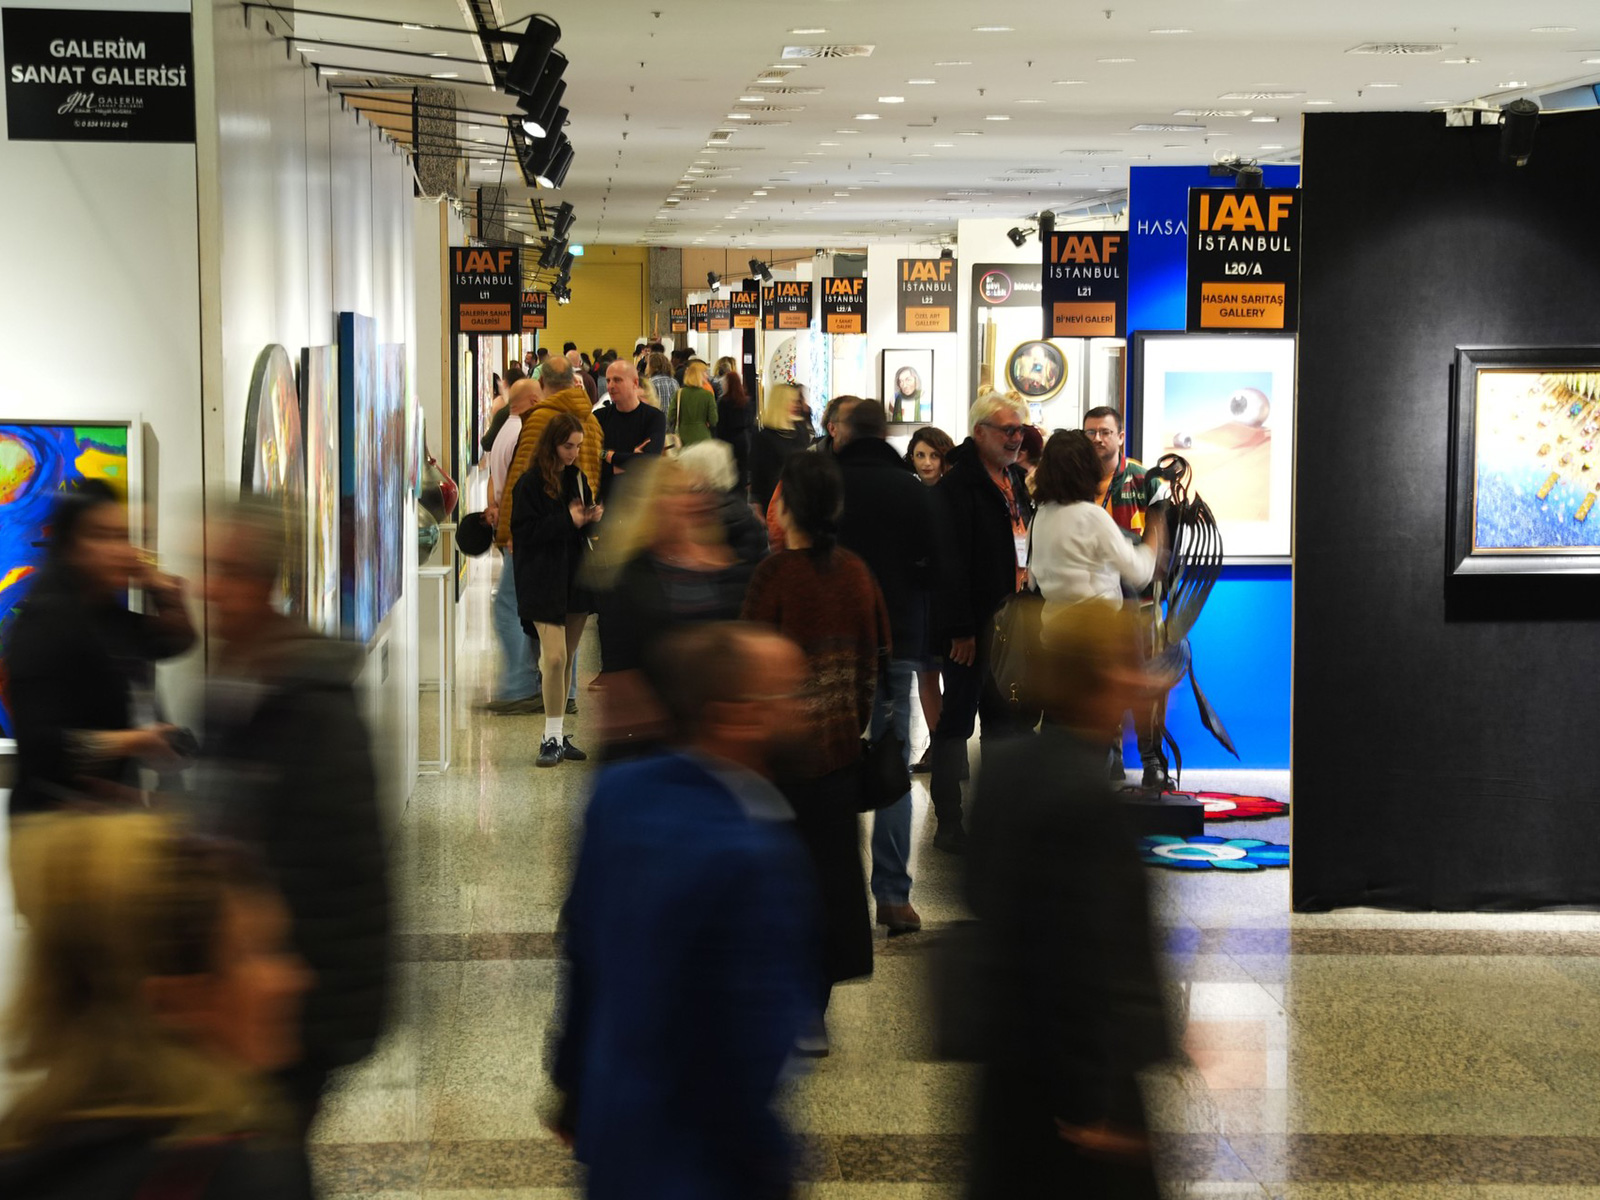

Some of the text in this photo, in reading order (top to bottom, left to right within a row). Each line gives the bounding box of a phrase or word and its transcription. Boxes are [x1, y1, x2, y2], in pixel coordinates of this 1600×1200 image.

[50, 36, 146, 59] GALERİM
[11, 64, 187, 87] SANAT GALERİSİ
[1200, 194, 1293, 232] IAAF
[1198, 234, 1291, 252] İSTANBUL
[1051, 236, 1121, 264] IAAF
[456, 250, 513, 273] IAAF
[903, 261, 952, 281] IAAF
[1050, 265, 1120, 279] İSTANBUL
[1225, 262, 1262, 276] L20/A
[456, 275, 513, 286] İSTANBUL
[825, 279, 864, 295] IAAF
[903, 281, 953, 292] İSTANBUL
[480, 291, 490, 299] L11
[777, 283, 809, 297] IAAF
[1077, 286, 1091, 296] L21
[522, 292, 546, 303] IAAF
[732, 292, 757, 303] IAAF
[825, 294, 863, 303] İSTANBUL
[922, 296, 933, 304] L22
[1203, 294, 1284, 306] HASAN SARITAŞ
[1085, 315, 1113, 324] GALERİ
[1220, 308, 1265, 318] GALLERY
